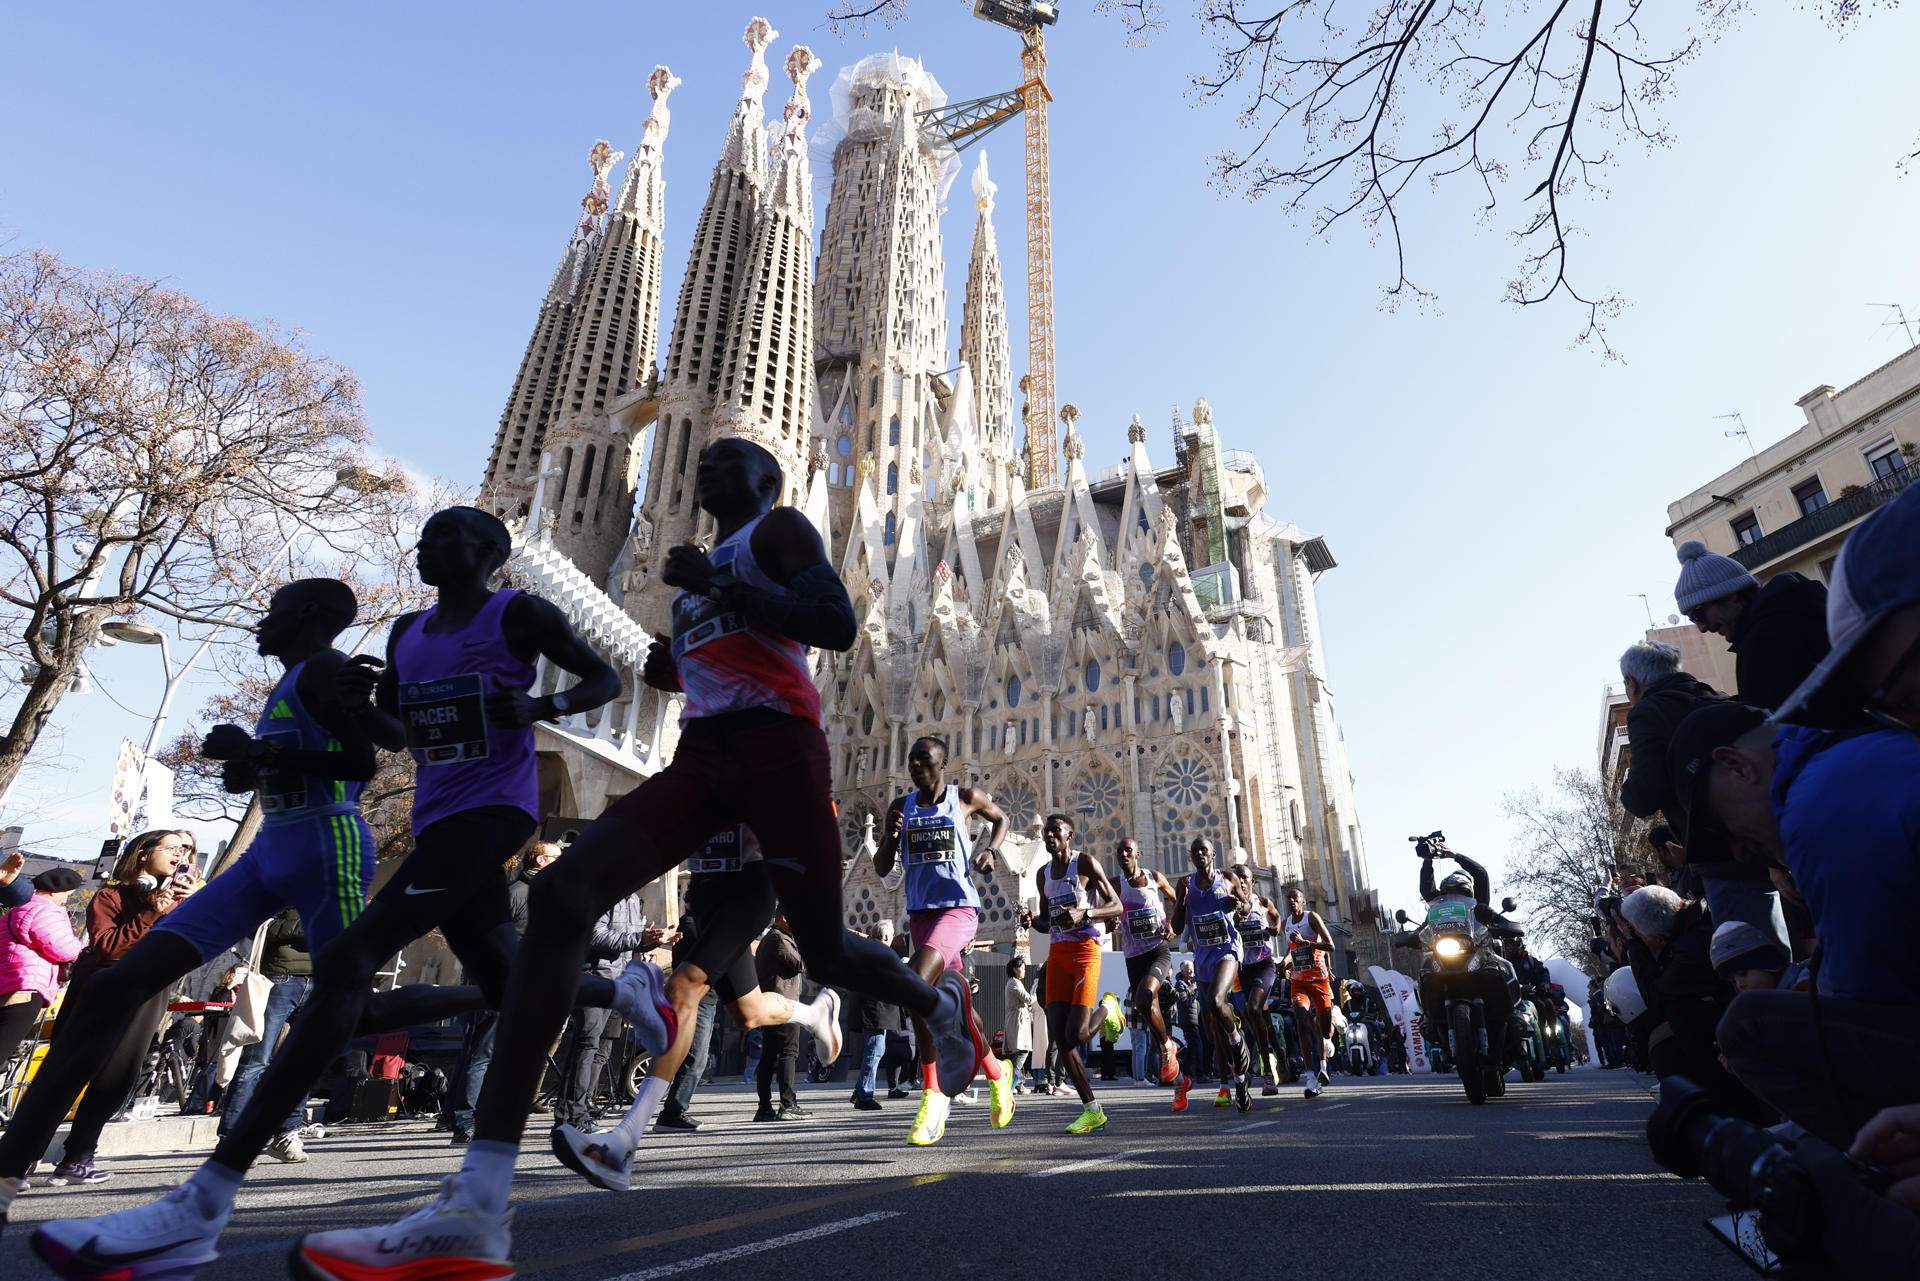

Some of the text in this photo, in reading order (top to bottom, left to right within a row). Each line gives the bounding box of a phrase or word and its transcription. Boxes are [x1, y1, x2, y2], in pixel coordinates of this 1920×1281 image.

[410, 705, 459, 727] PACER
[911, 830, 950, 843] ONCHARI
[1410, 1017, 1423, 1057] YAMAHA
